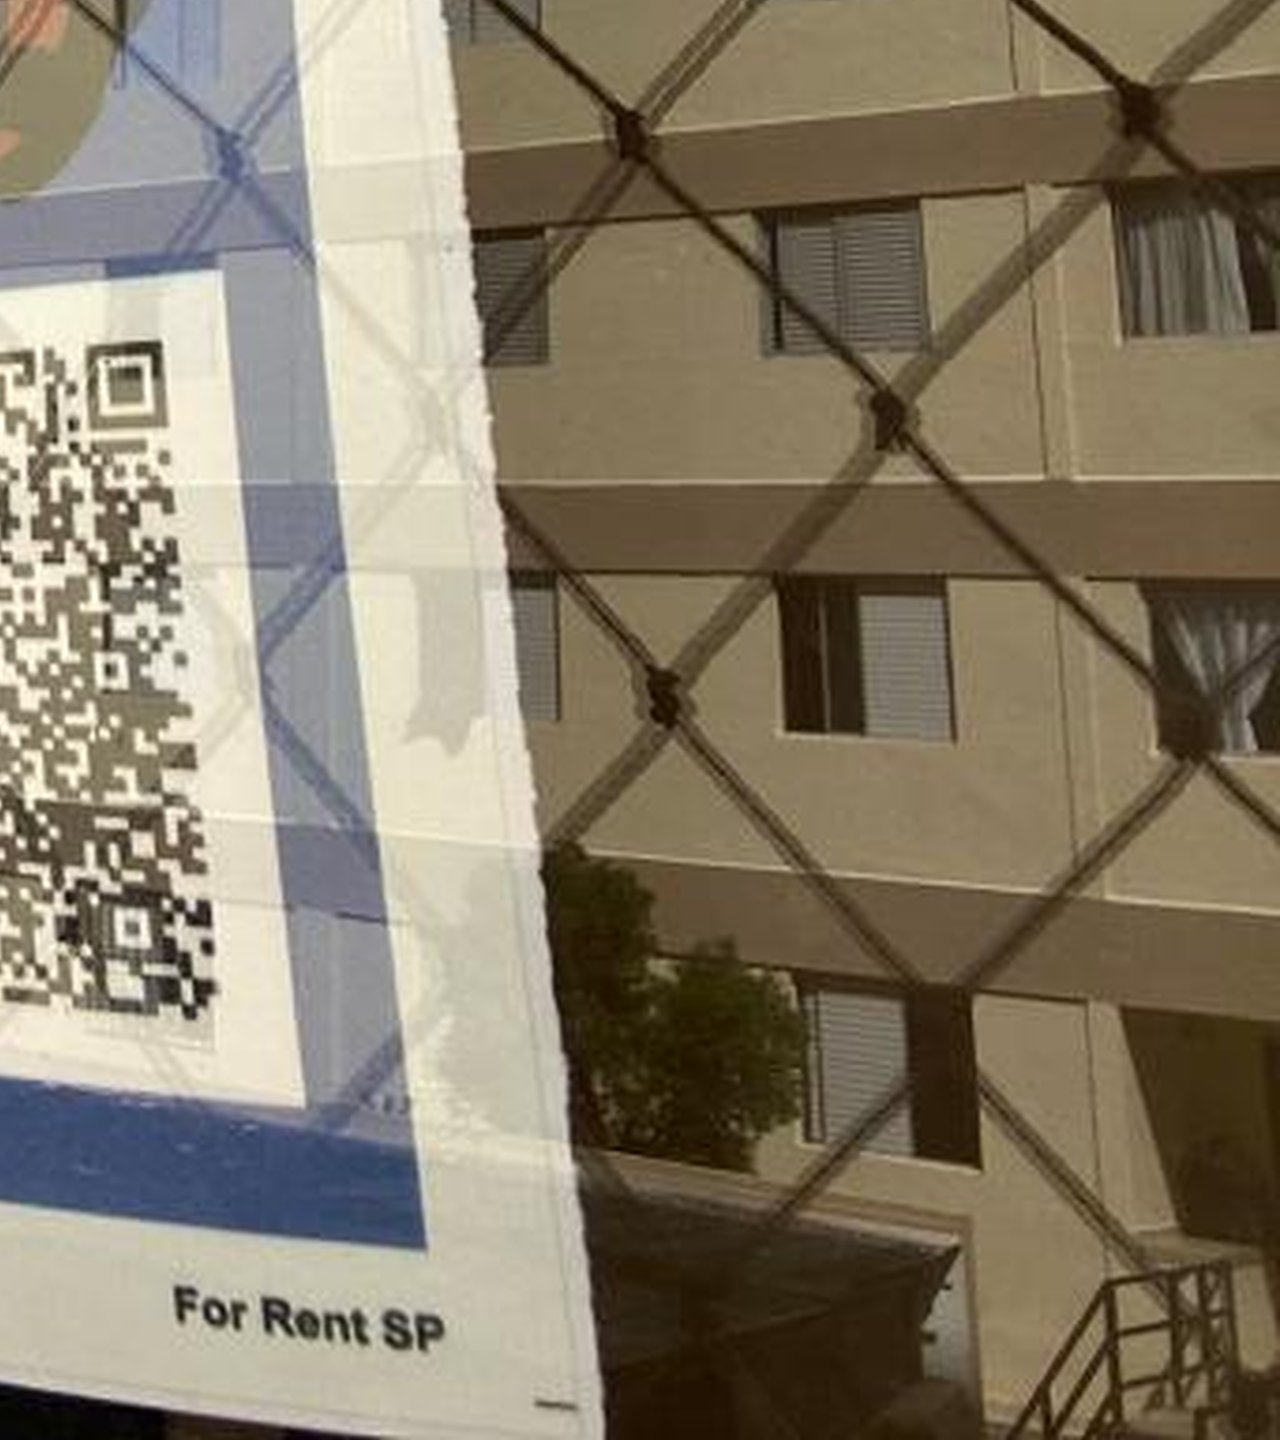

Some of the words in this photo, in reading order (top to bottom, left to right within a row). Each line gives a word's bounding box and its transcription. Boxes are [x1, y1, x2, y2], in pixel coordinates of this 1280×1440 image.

[173, 1283, 248, 1332] For
[260, 1297, 370, 1346] Rent
[382, 1309, 446, 1353] SP
